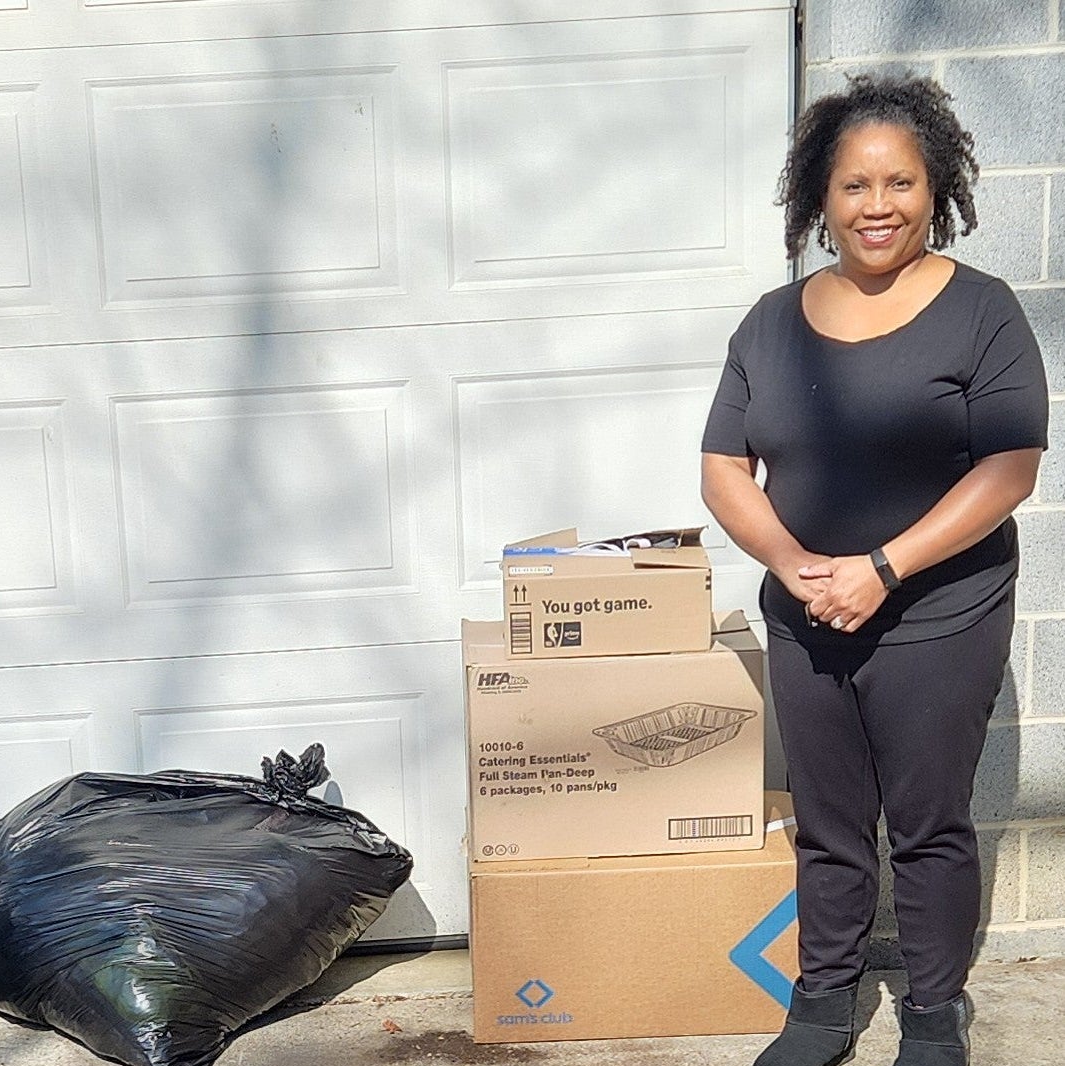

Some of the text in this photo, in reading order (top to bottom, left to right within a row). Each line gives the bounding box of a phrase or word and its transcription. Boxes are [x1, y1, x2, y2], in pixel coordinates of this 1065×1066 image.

[542, 598, 652, 615] You got game.
[478, 672, 511, 686] HFA
[479, 741, 524, 752] 10010-6
[479, 757, 526, 768] Catering
[479, 767, 595, 782] Full Steam Pan-Deep
[480, 780, 617, 797] 6 packages, 10 pans/pkg
[541, 1011, 573, 1024] club
